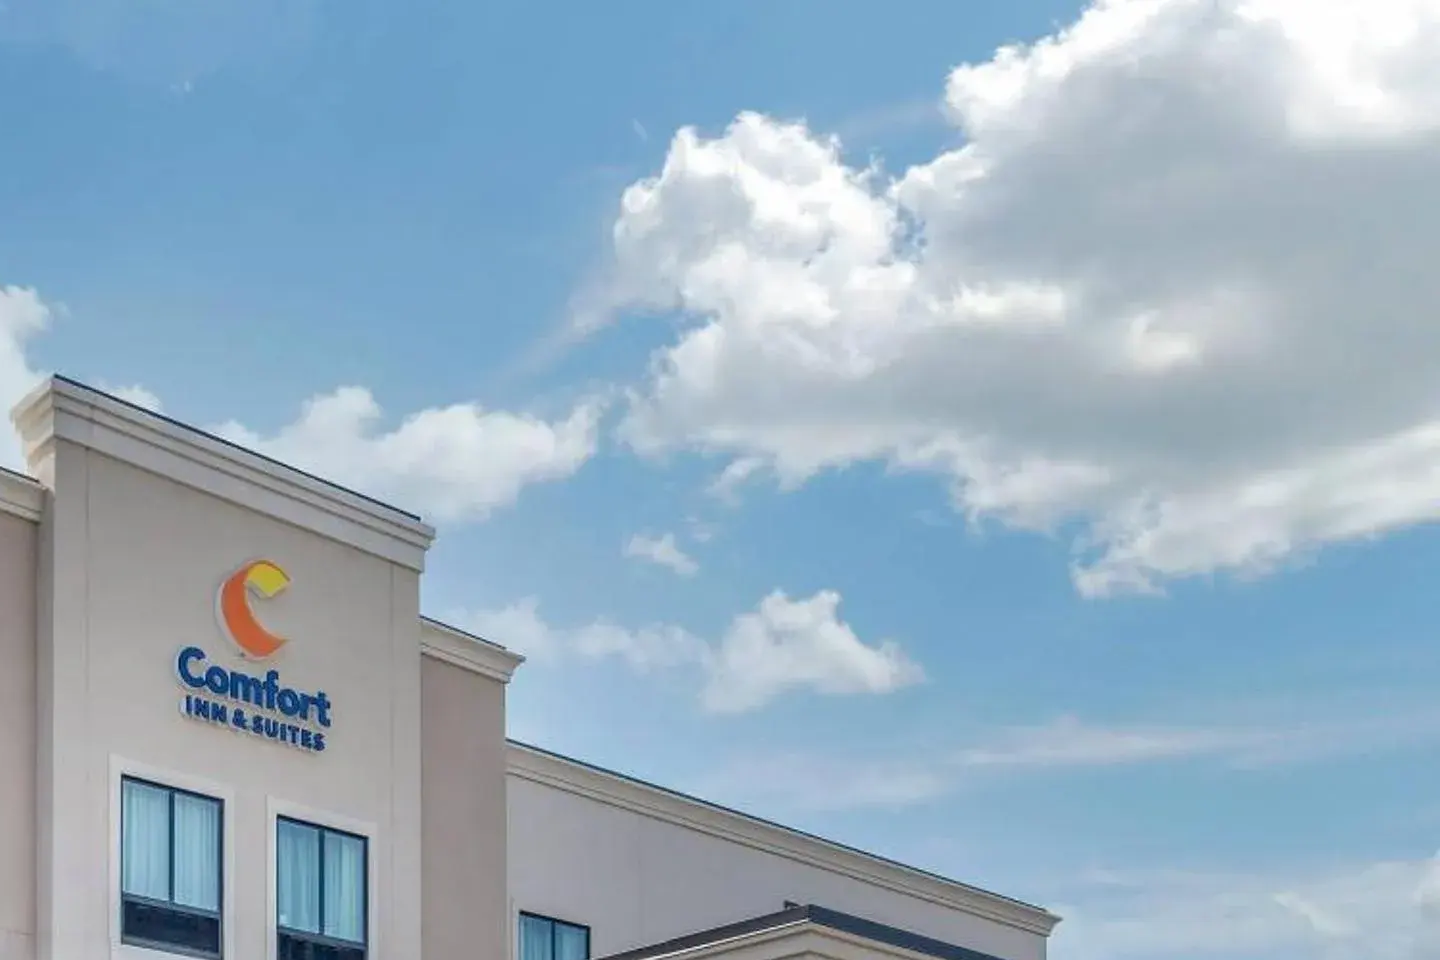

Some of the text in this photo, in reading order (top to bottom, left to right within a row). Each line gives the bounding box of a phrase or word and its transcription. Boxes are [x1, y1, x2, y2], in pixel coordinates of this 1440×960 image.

[176, 646, 331, 728] Comfort
[185, 695, 326, 751] INN & SUITES
